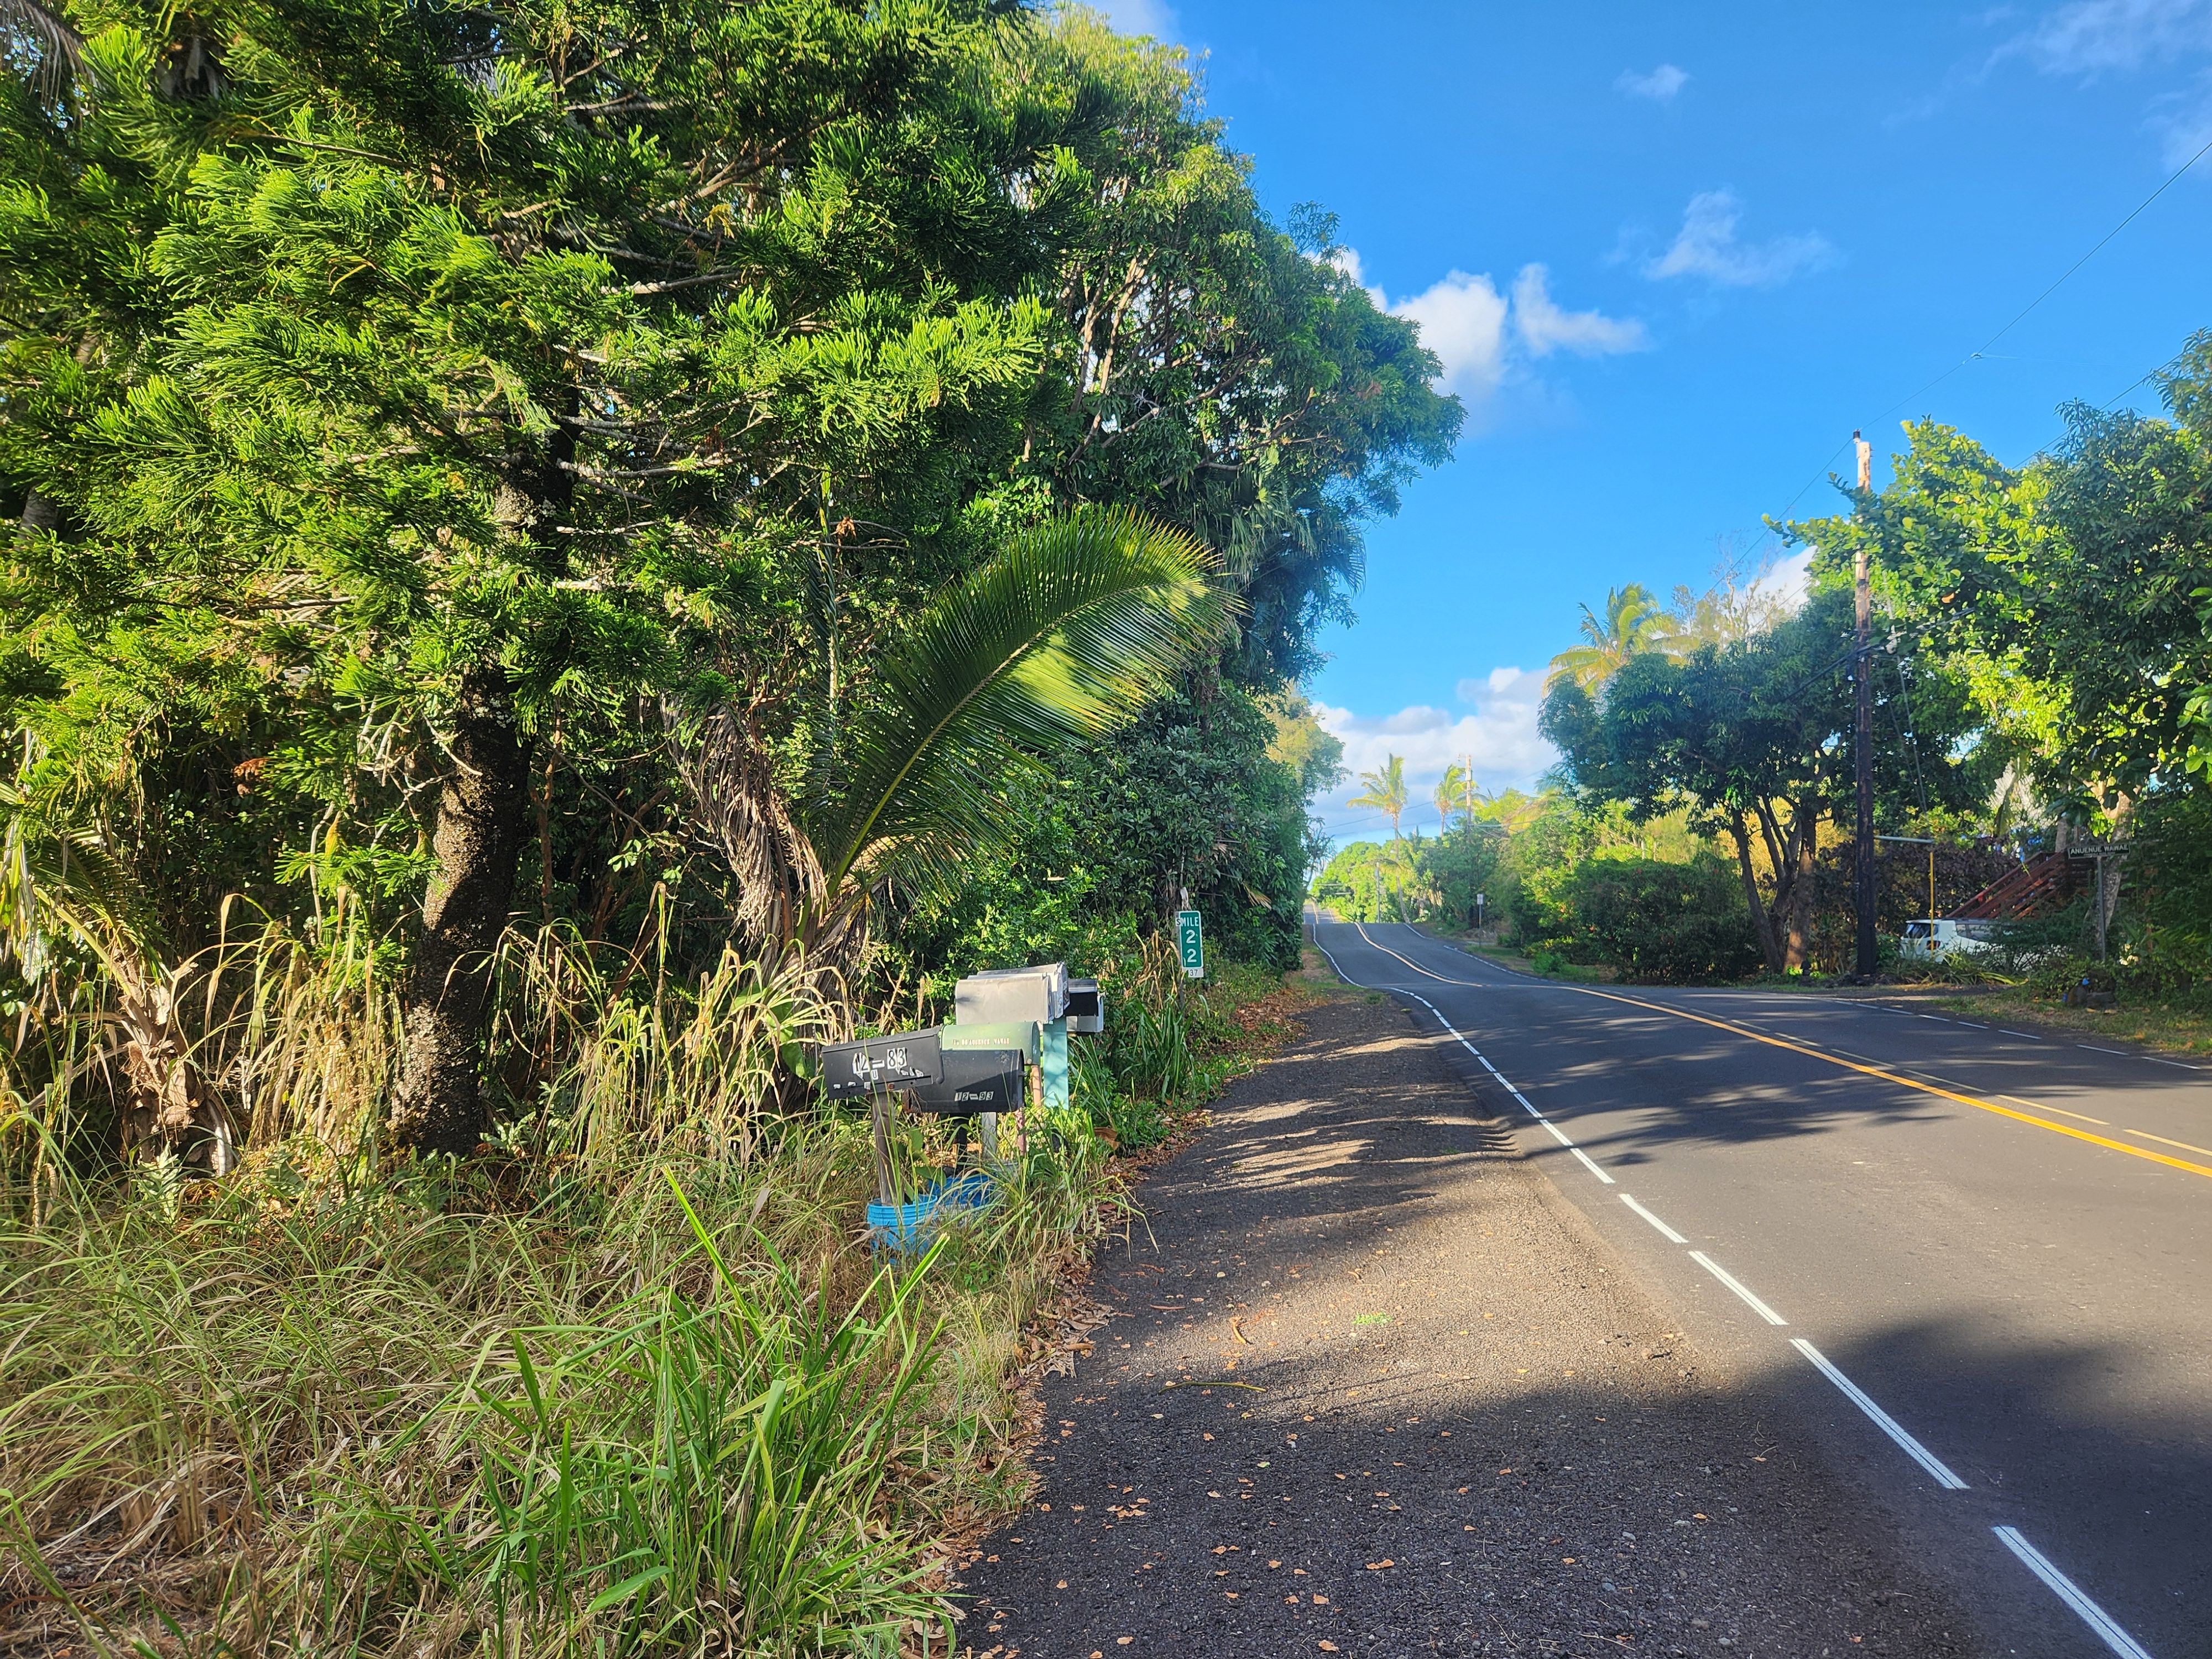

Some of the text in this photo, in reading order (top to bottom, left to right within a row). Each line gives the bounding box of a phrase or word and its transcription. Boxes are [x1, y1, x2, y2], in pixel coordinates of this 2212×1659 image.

[2070, 844, 2128, 854] ANUENUE WAWAE
[1181, 916, 1199, 927] MILE
[957, 1092, 993, 1100] 12-93
